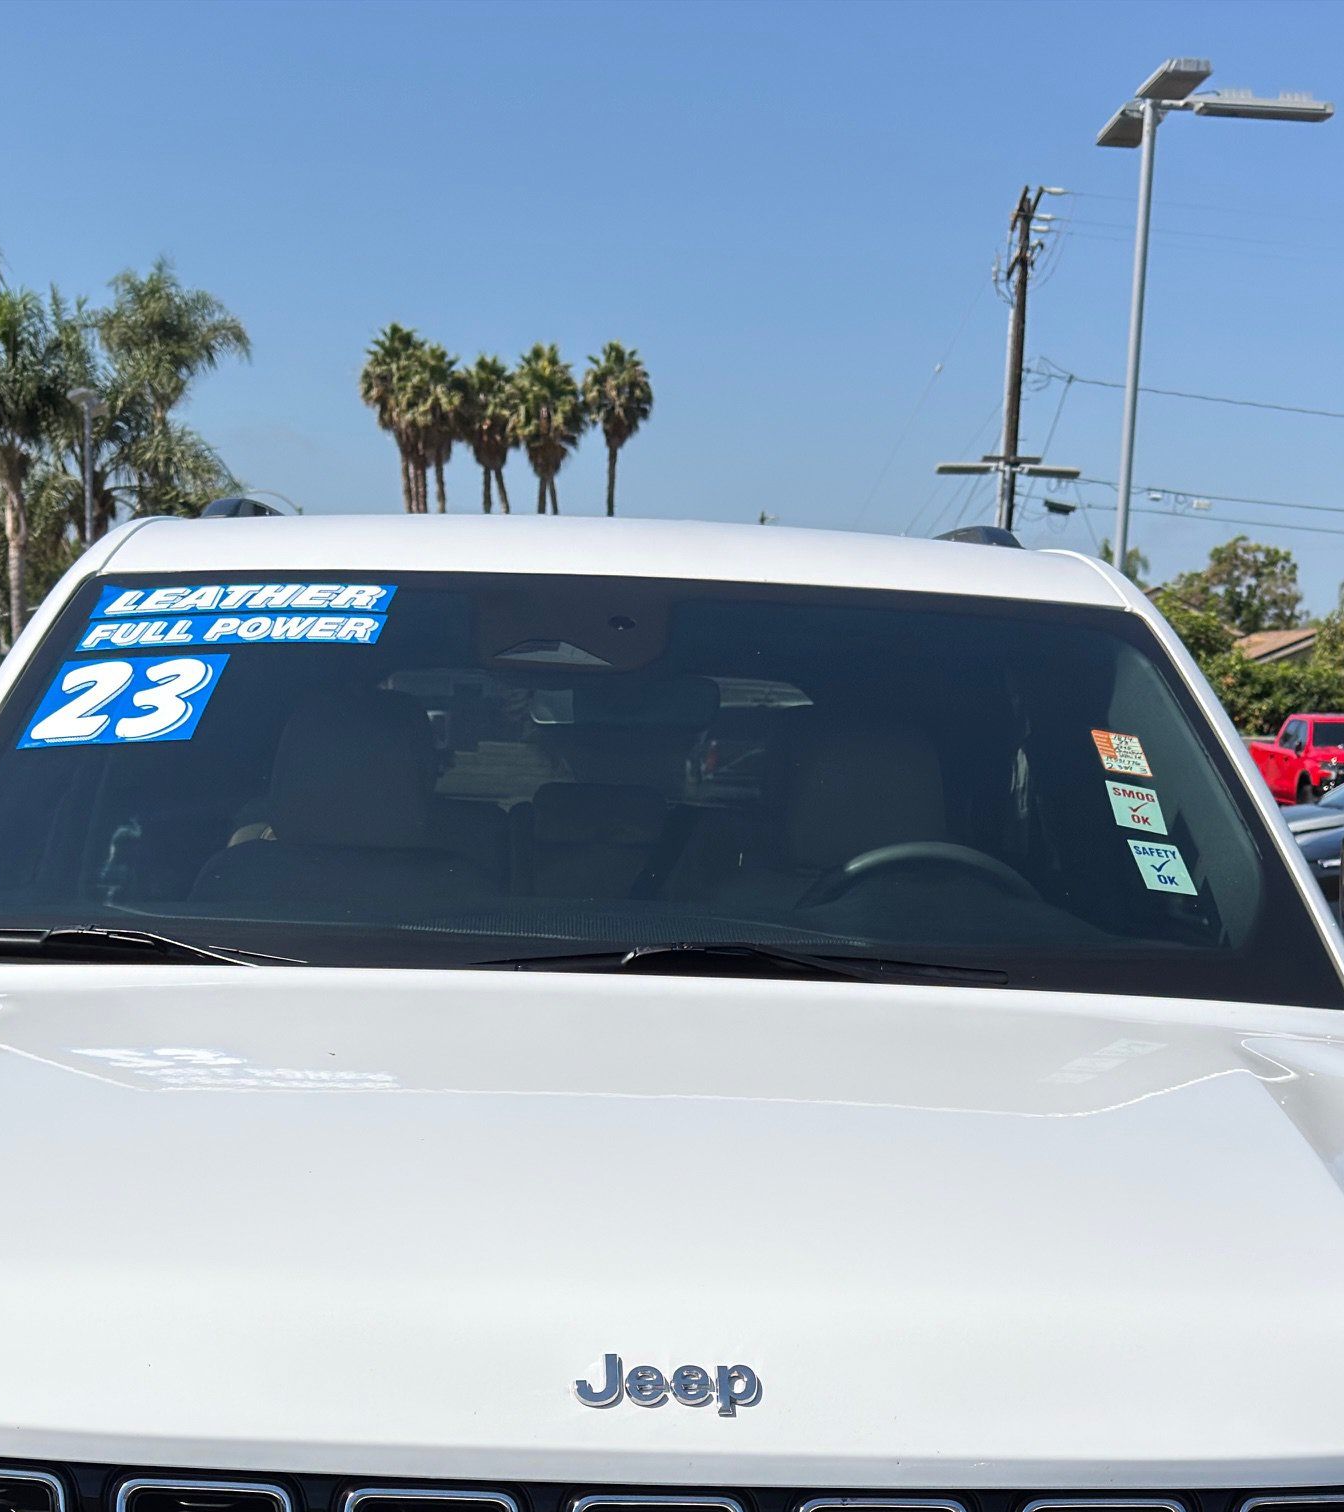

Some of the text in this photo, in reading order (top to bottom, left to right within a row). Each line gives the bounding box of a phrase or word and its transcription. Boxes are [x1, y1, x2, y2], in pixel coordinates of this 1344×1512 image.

[104, 585, 388, 615] LEATHER
[81, 615, 380, 648] FULL POWER
[31, 658, 214, 744] 23
[1112, 787, 1155, 803] SMOG
[1131, 814, 1152, 826] OK
[1133, 846, 1178, 860] SAFETY
[1157, 874, 1179, 886] OK
[574, 1353, 763, 1417] Jeep
